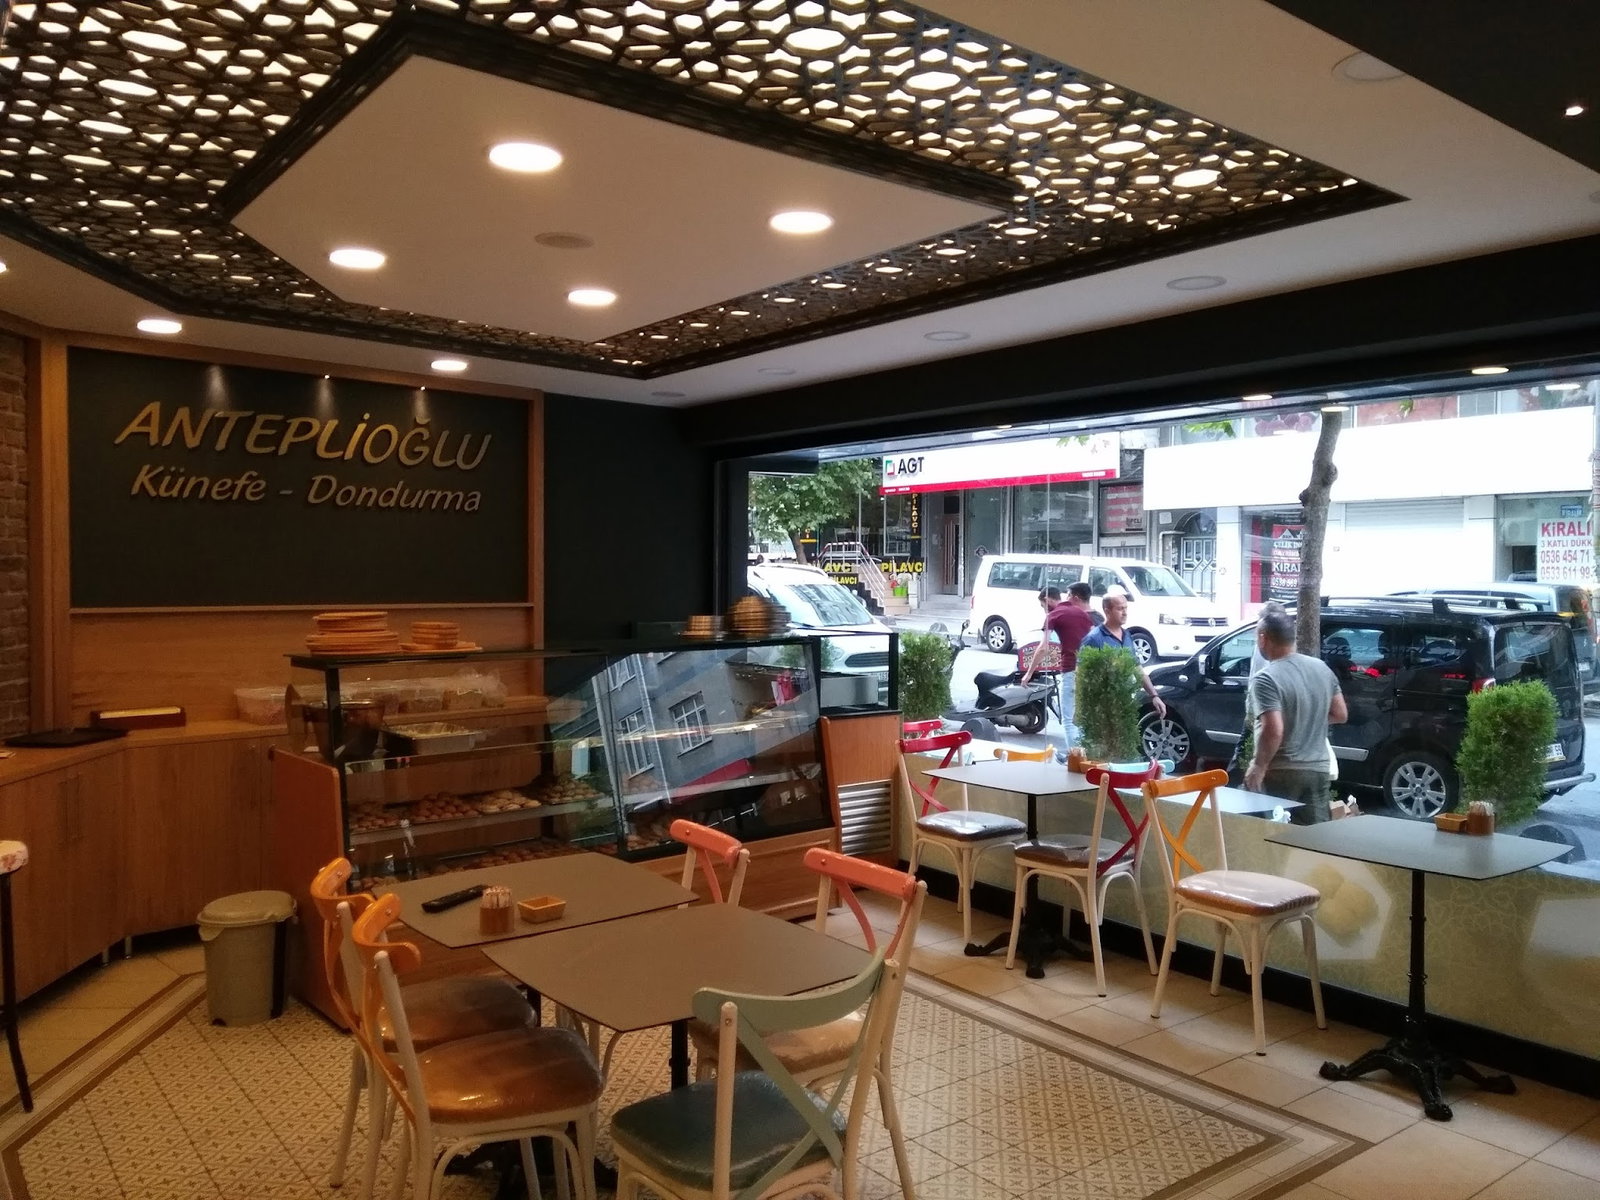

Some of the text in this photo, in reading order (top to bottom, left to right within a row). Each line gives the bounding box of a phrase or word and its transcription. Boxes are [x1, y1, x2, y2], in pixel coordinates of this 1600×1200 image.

[113, 400, 492, 470] ANTEPLİOĞLU
[898, 456, 924, 474] AGT
[131, 464, 267, 501] Künefe
[307, 475, 482, 512] Dondurma
[1541, 521, 1591, 537] KİRALI
[1547, 540, 1569, 548] KATLI
[1570, 538, 1593, 547] DÜKK
[1562, 550, 1578, 564] 454
